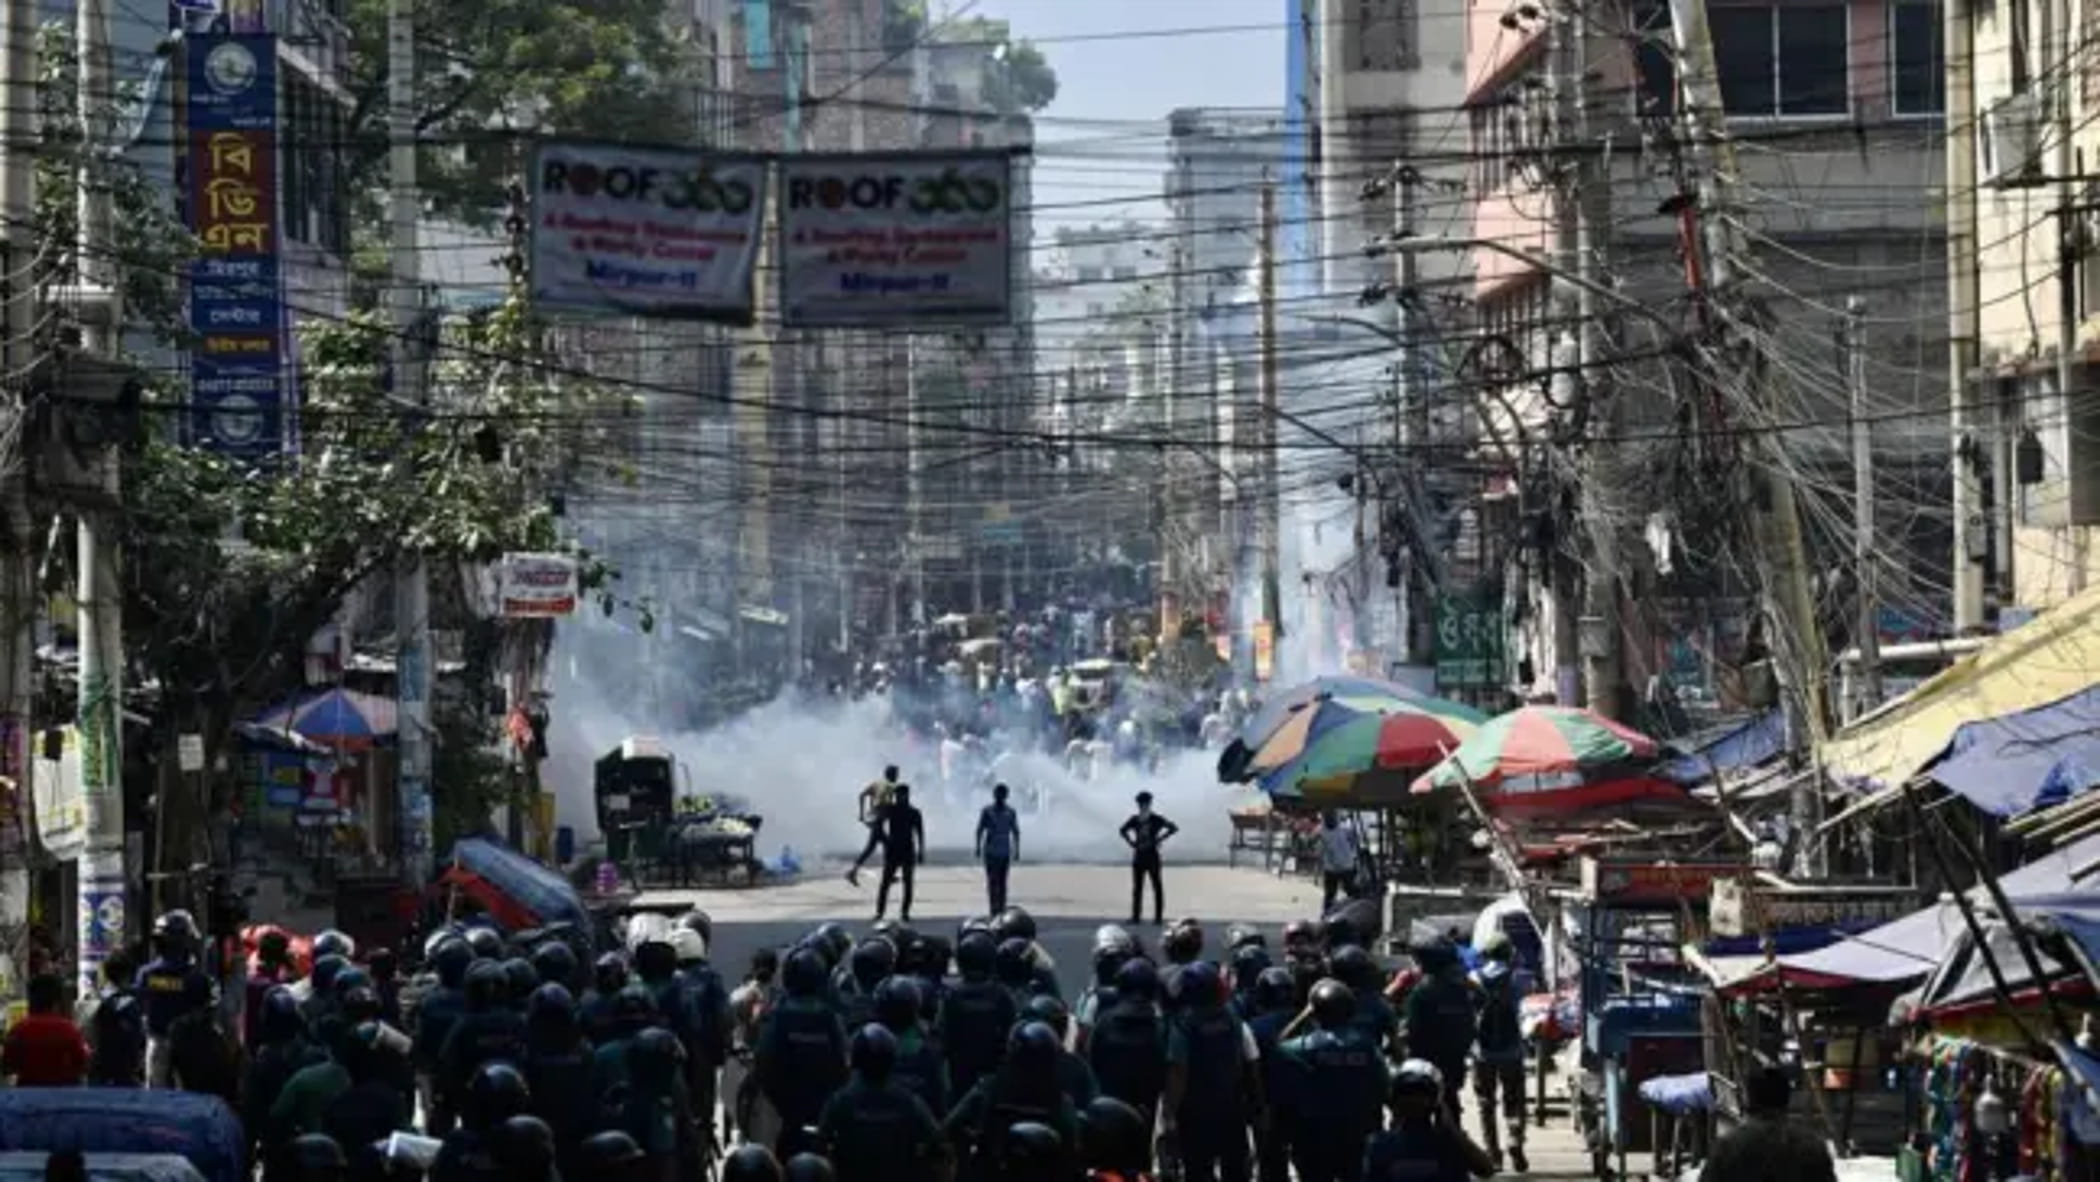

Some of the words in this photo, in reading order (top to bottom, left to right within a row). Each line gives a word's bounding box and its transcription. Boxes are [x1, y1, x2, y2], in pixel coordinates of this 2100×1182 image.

[209, 131, 254, 175] বি
[203, 177, 261, 220] ডি
[543, 161, 661, 200] ROOF
[788, 176, 904, 210] ROOF
[203, 222, 269, 254] এন
